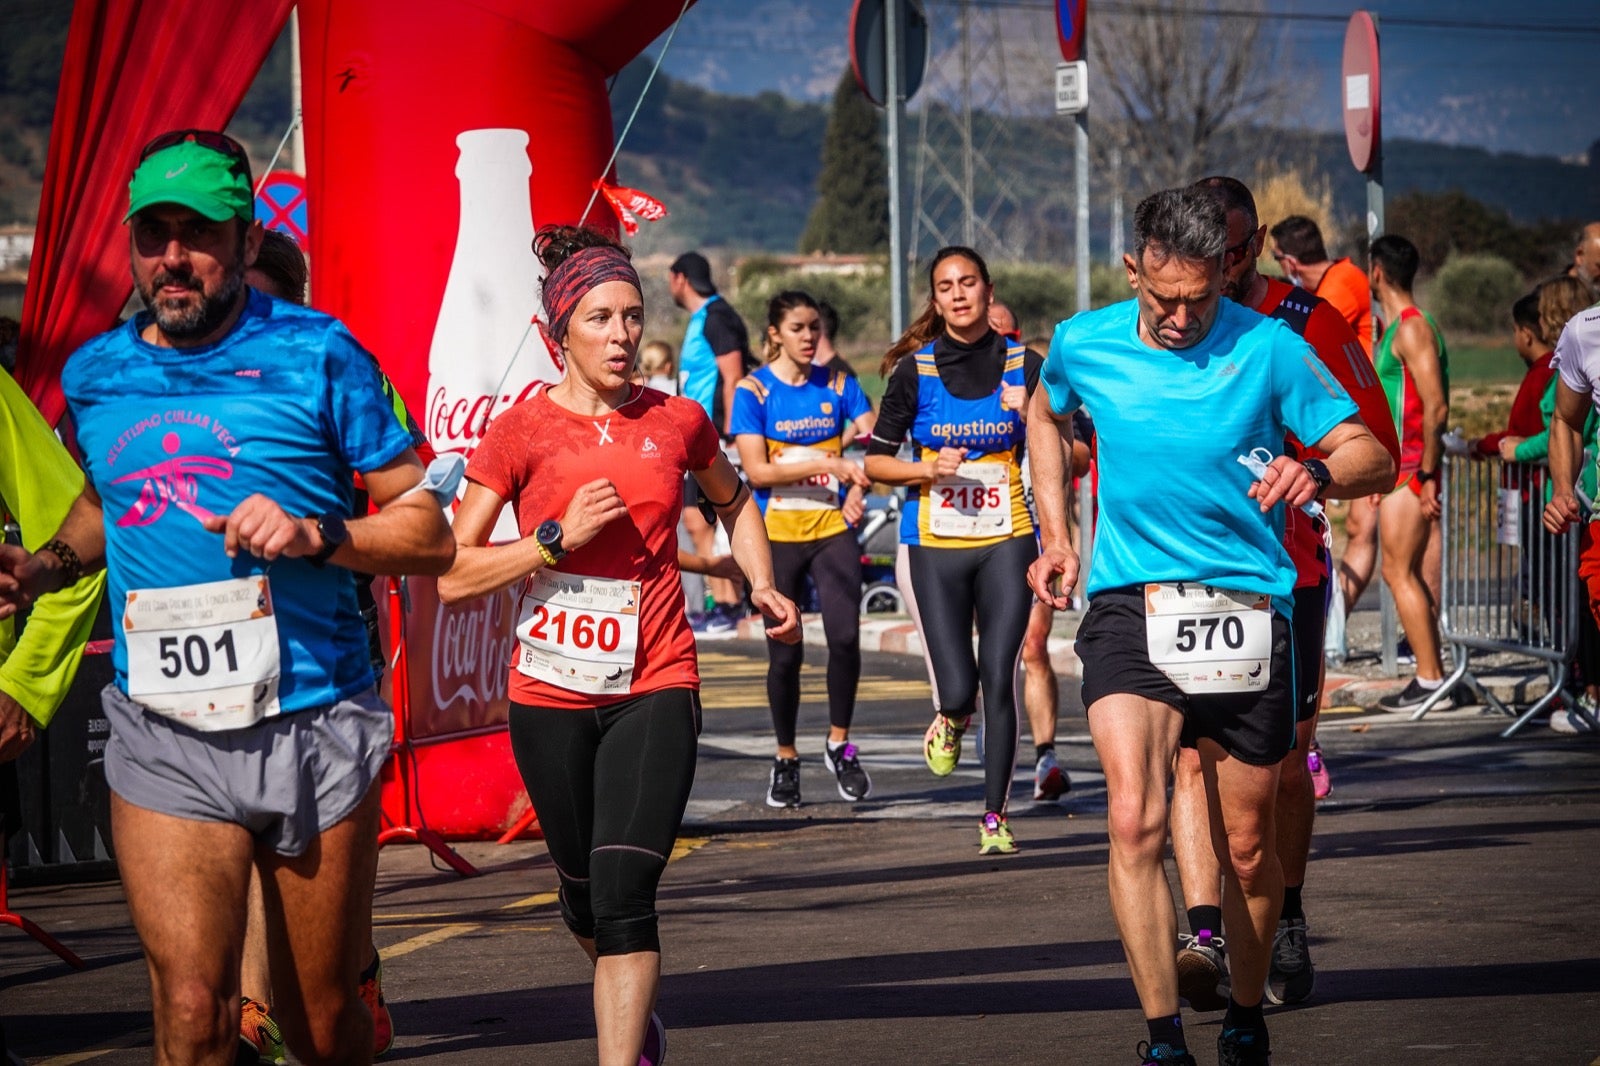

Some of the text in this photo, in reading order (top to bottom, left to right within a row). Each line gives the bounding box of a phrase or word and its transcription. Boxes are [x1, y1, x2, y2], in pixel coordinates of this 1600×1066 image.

[107, 413, 162, 466] ATLETISMO
[164, 410, 211, 429] CULLAR
[775, 416, 835, 436] agustinos
[931, 418, 1014, 440] agustinos
[940, 486, 1000, 509] 2185
[528, 605, 621, 653] 2160
[1175, 615, 1245, 653] 570
[159, 629, 238, 679] 501
